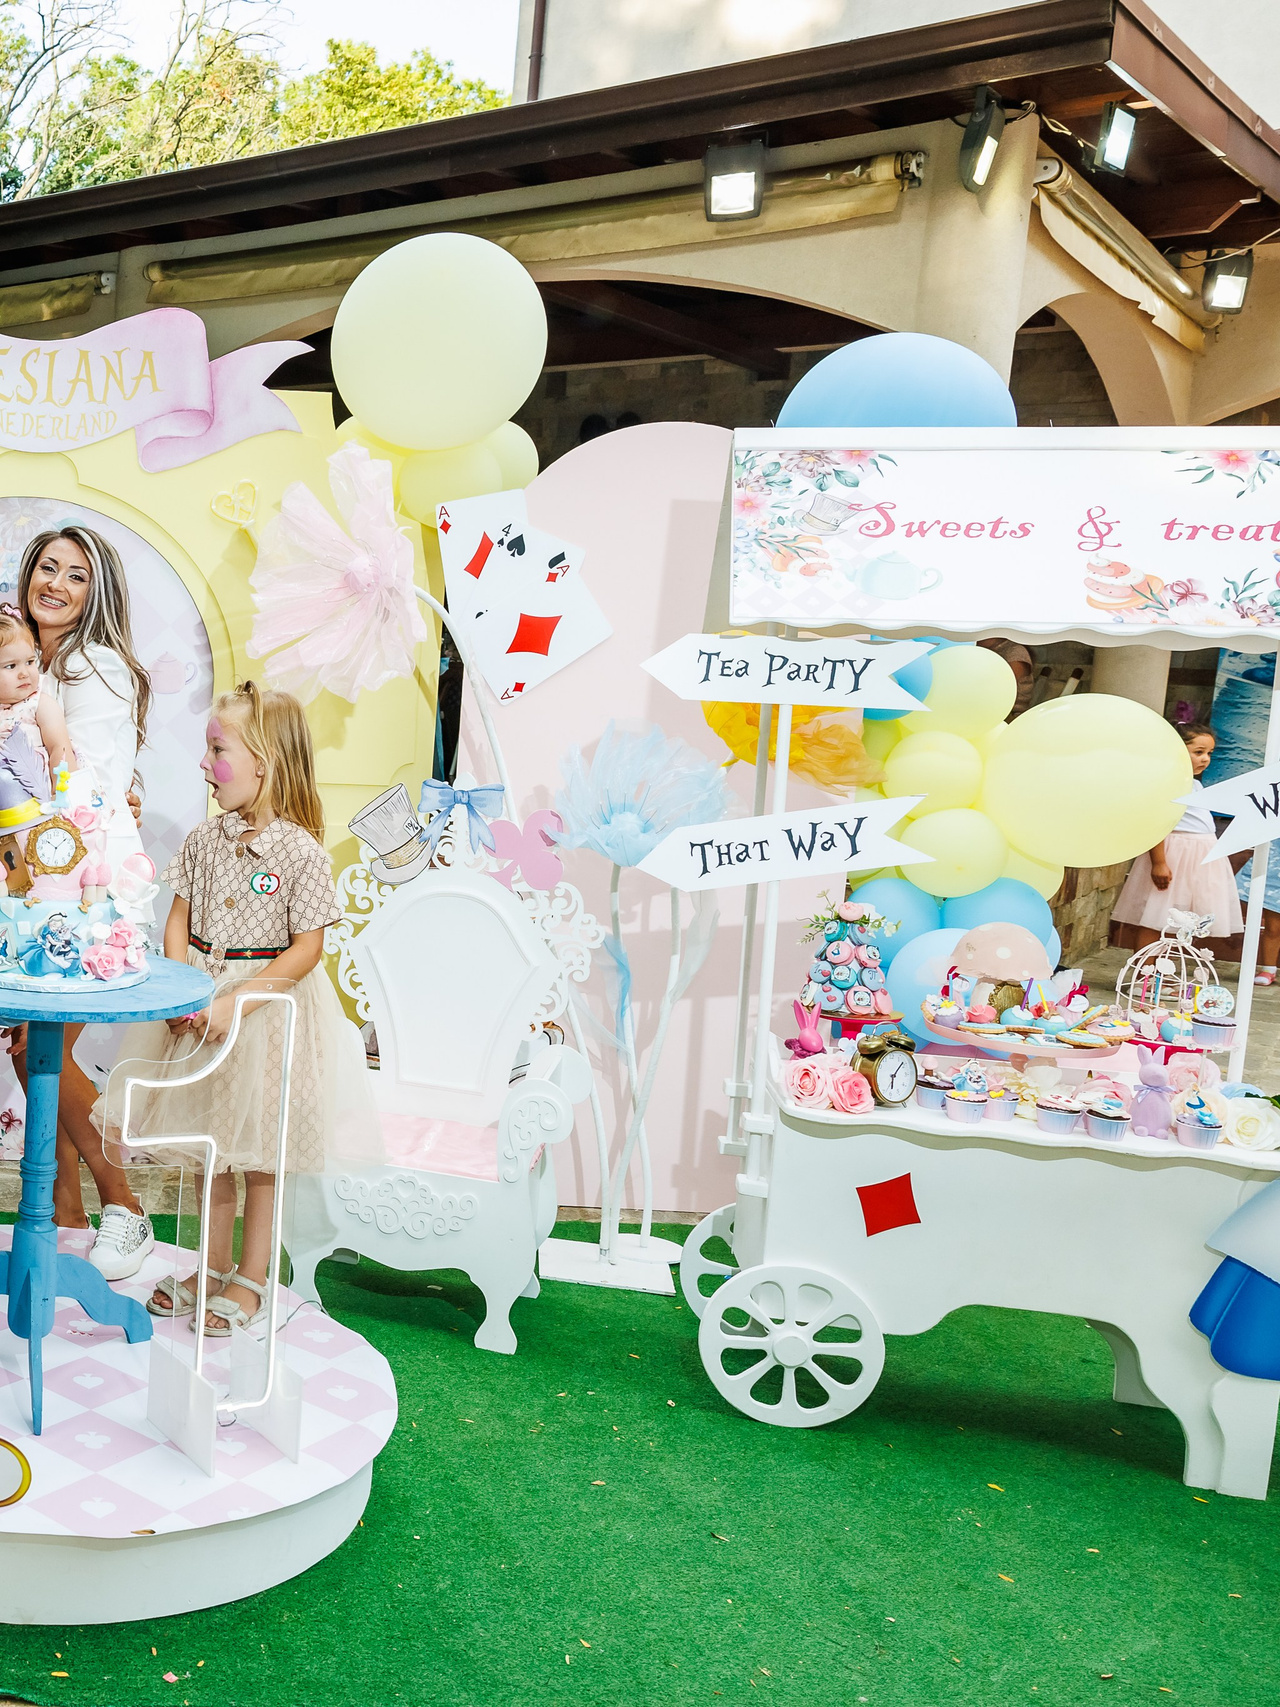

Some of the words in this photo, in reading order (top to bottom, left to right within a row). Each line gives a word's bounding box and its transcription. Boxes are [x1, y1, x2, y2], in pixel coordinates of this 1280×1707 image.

[438, 505, 451, 520] A
[501, 523, 513, 537] 4
[847, 501, 1036, 539] Sweets
[1076, 505, 1123, 552] &
